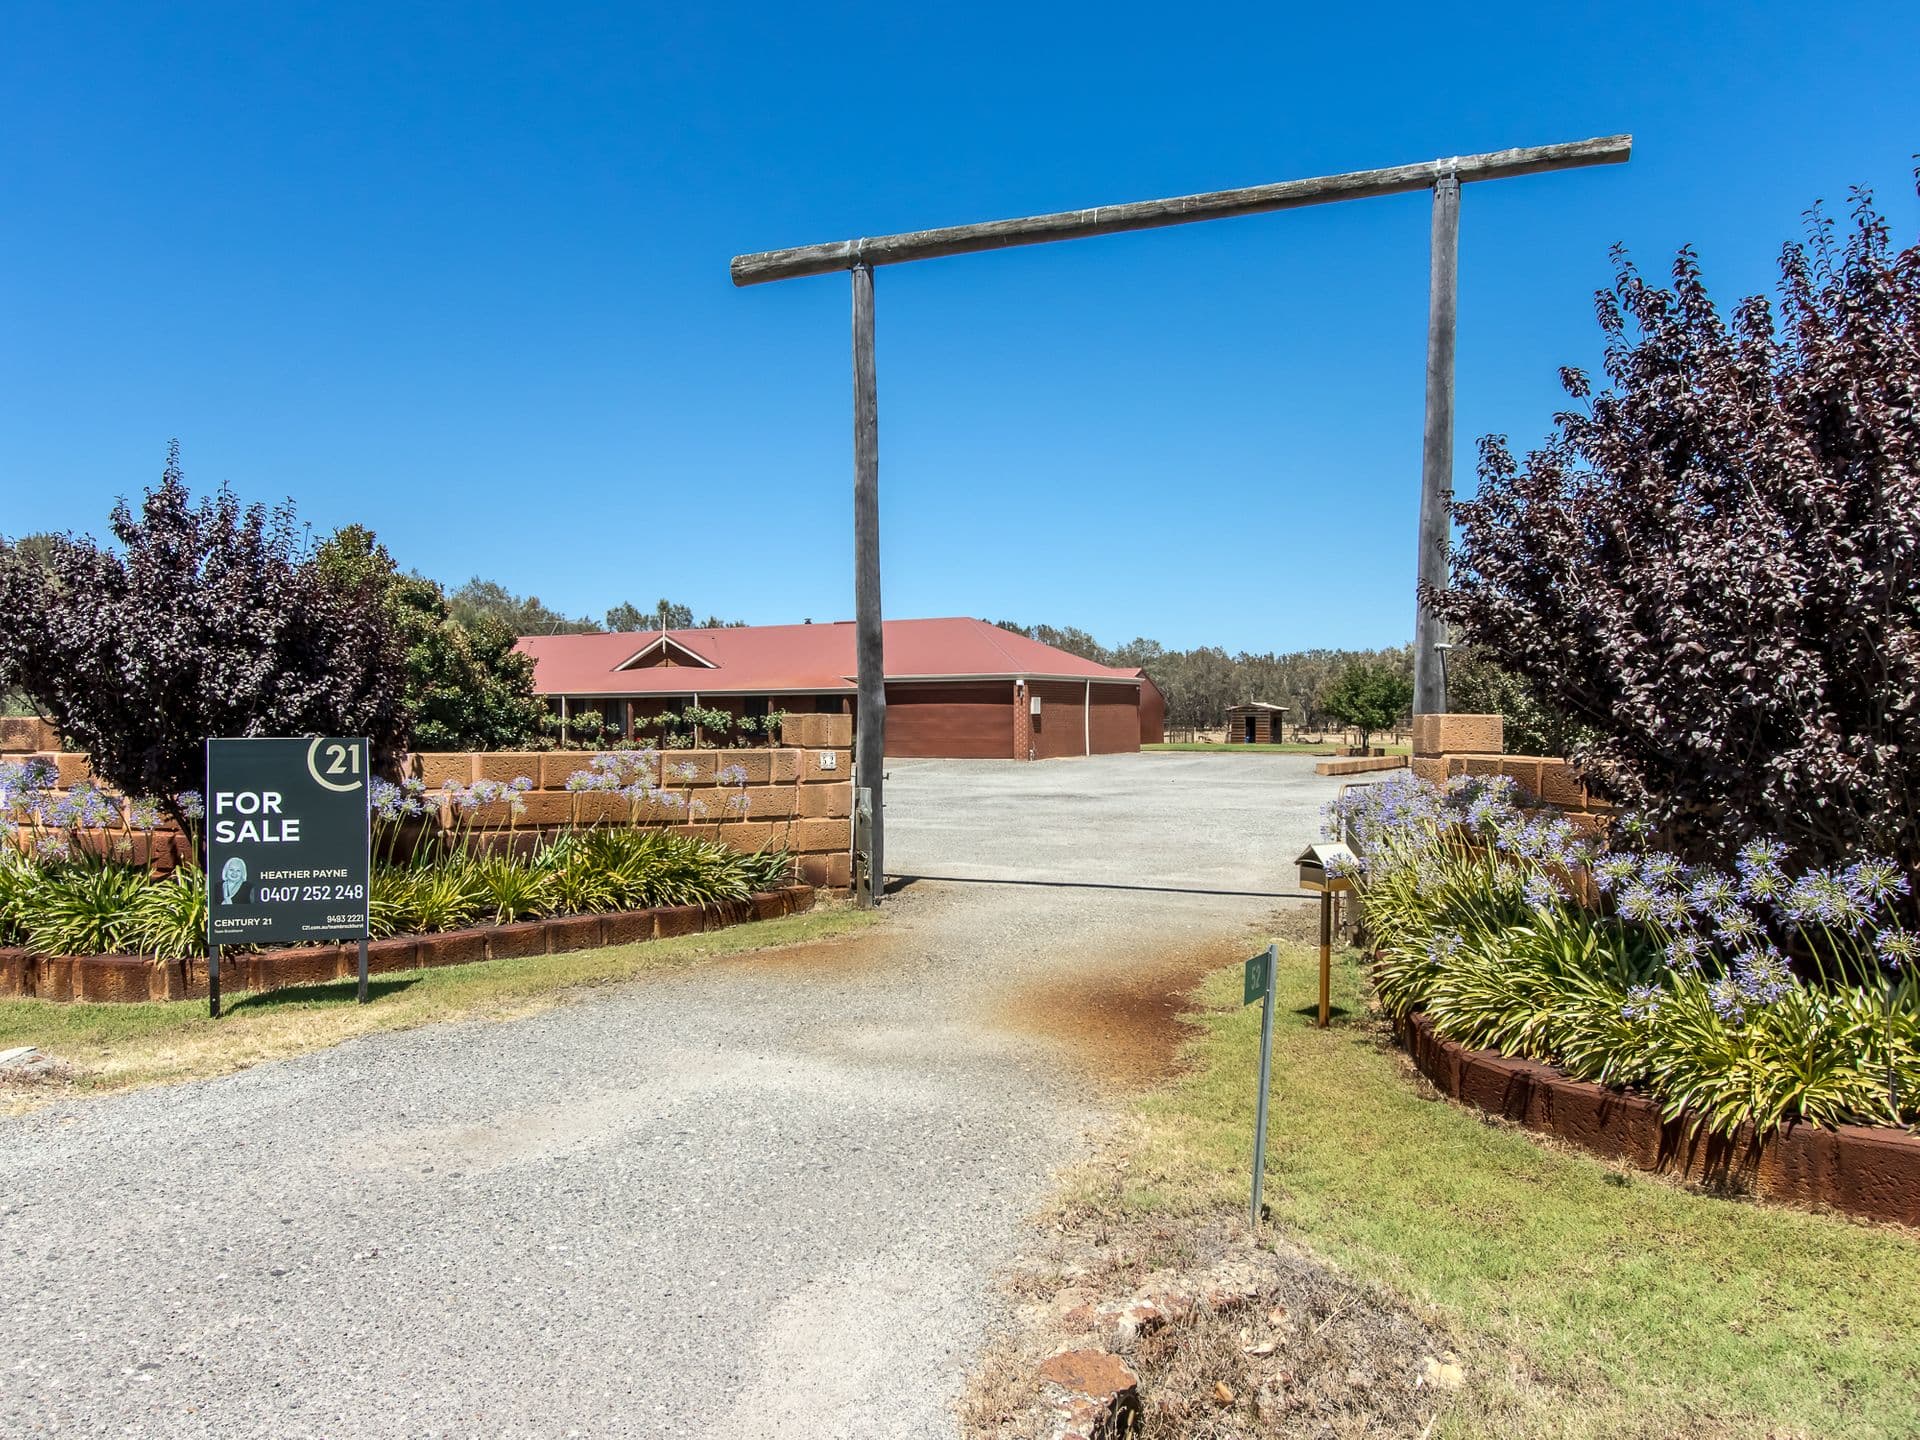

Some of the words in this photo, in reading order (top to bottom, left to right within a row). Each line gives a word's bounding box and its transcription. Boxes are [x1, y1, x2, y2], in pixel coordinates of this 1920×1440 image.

[215, 791, 282, 815] FOR
[215, 819, 300, 843] SALE
[260, 870, 311, 880] HEATHER
[312, 869, 348, 879] PAYNE
[260, 886, 299, 902] 0407
[302, 885, 331, 901] 252
[334, 884, 364, 900] 248
[214, 918, 260, 927] CENTURY
[262, 918, 272, 926] 21
[326, 915, 346, 923] 9493
[347, 914, 364, 922] 2221
[1251, 963, 1262, 991] 52
